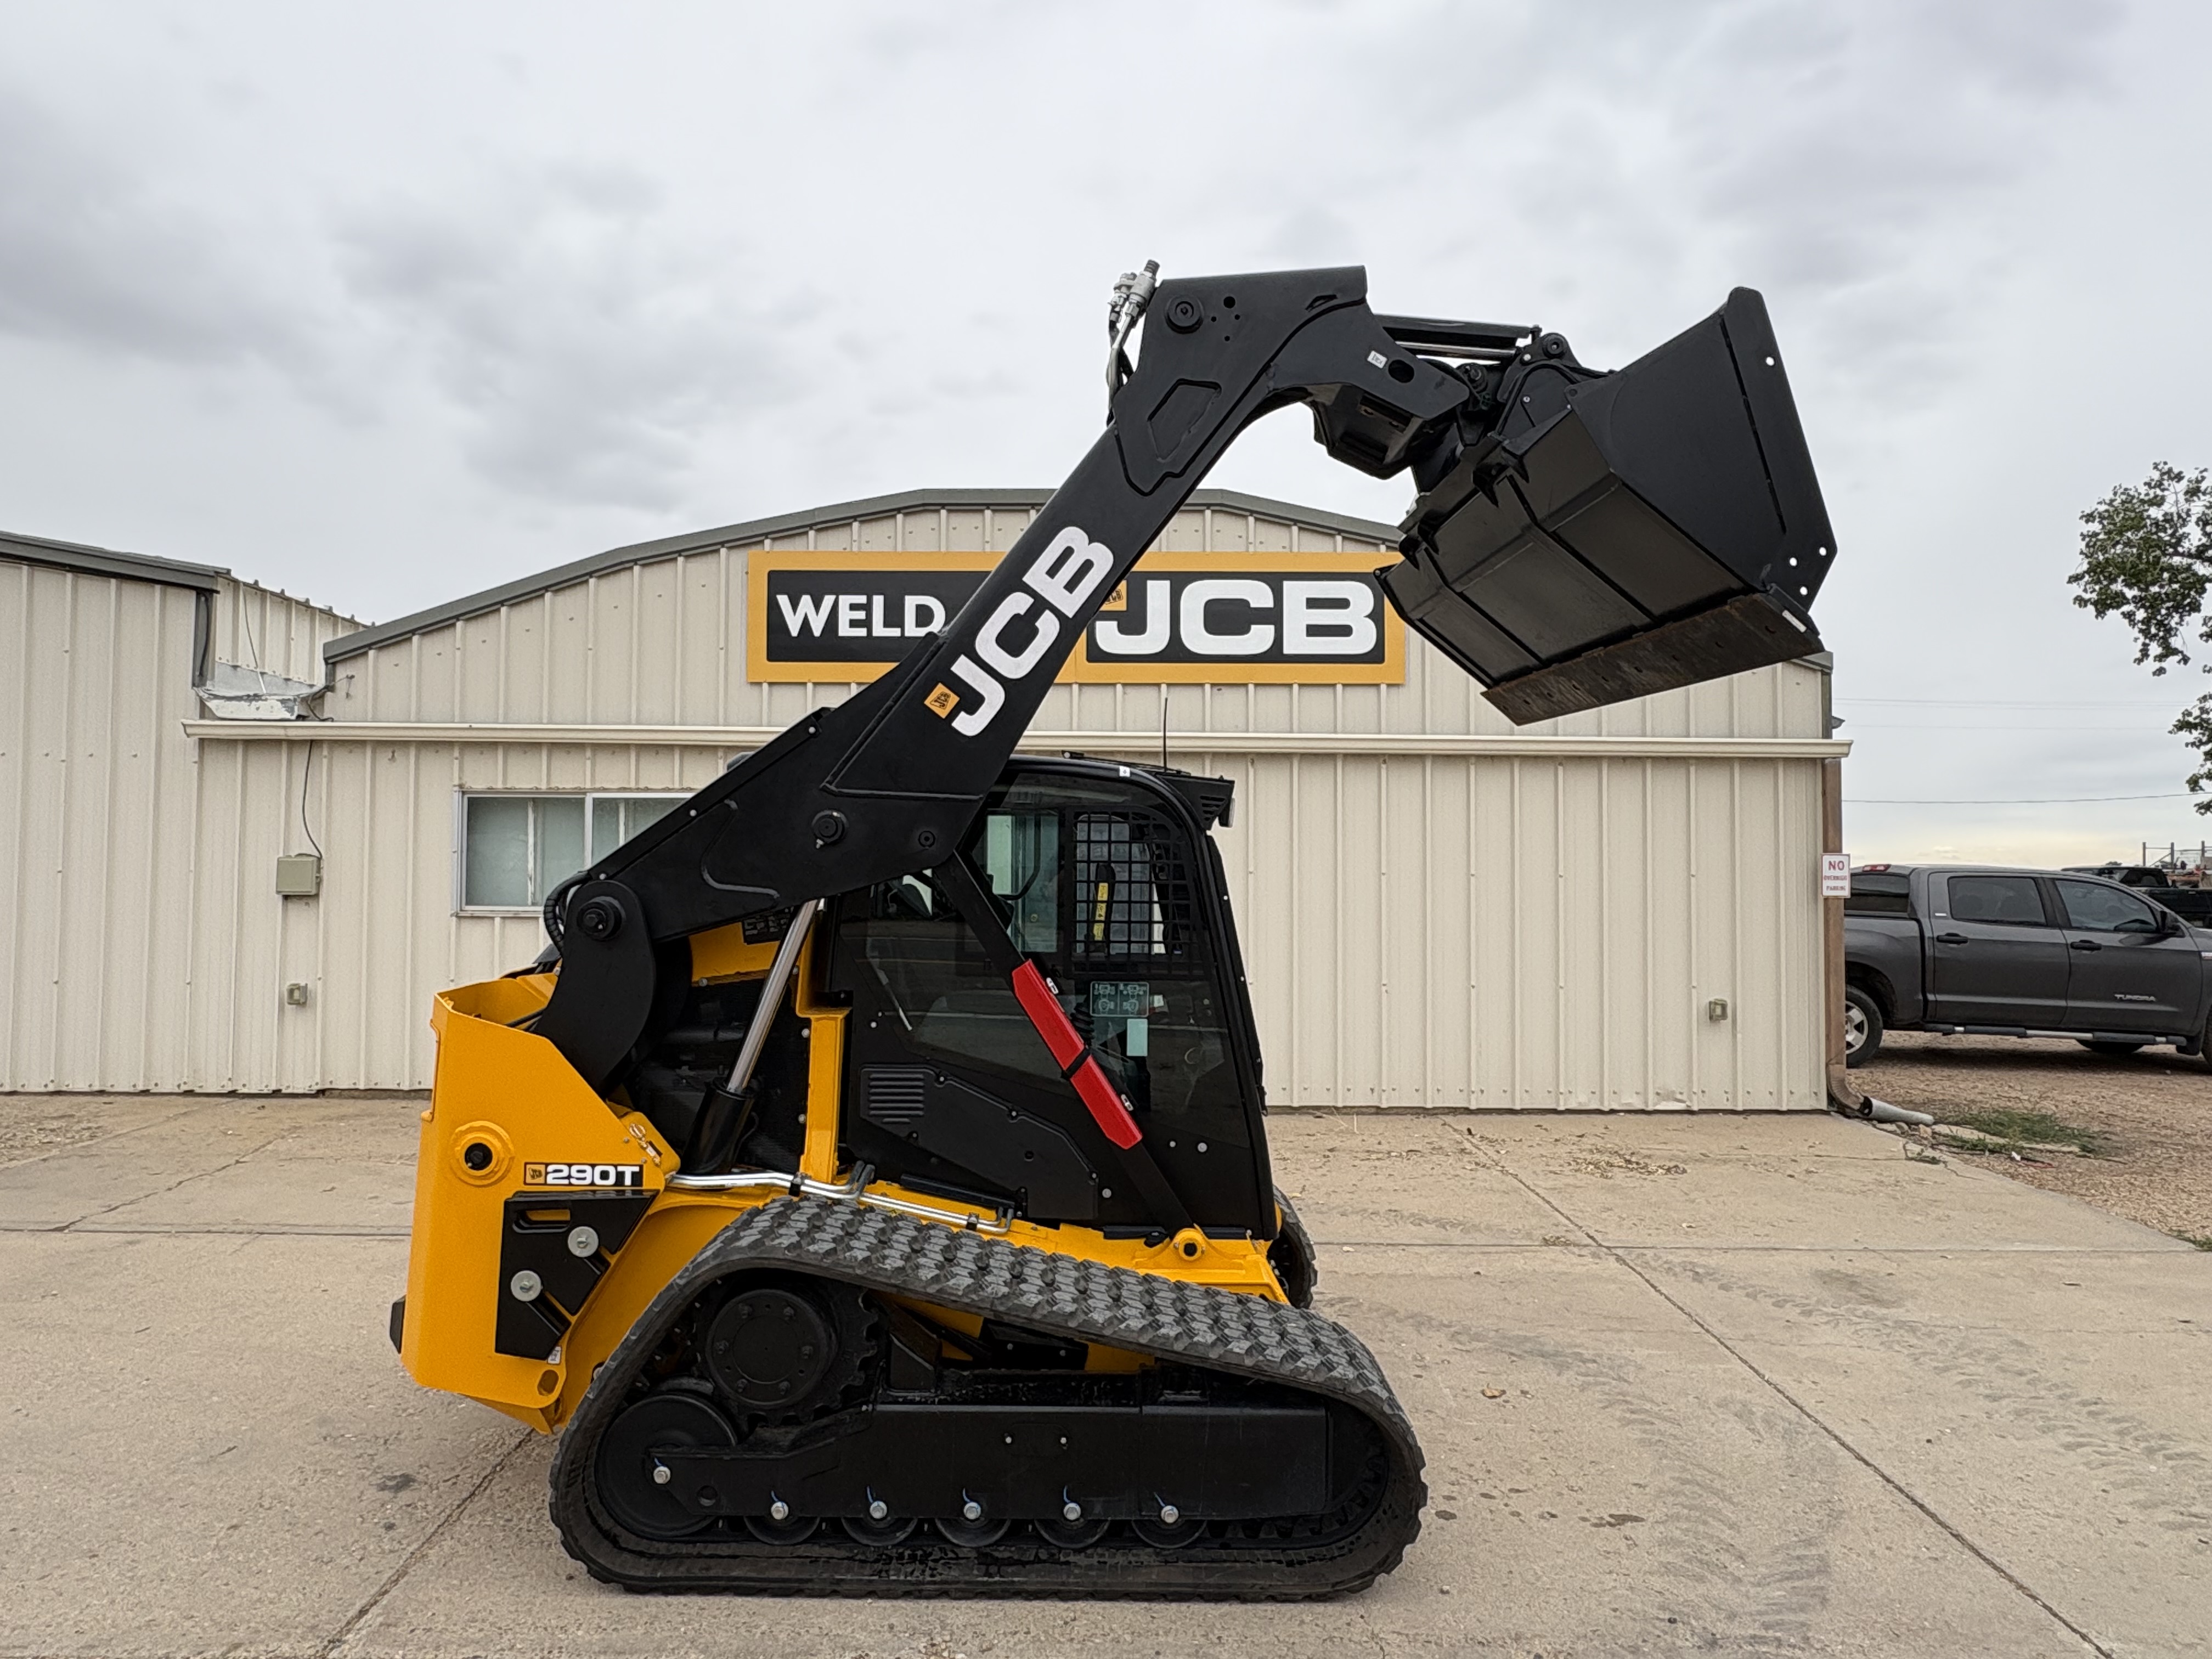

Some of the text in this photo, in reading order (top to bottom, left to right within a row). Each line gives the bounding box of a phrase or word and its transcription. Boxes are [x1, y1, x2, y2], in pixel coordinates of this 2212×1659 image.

[776, 595, 946, 637] WELD
[950, 526, 1114, 736] JCB
[1096, 579, 1376, 655] JCB
[1829, 860, 1844, 871] NO
[546, 1164, 640, 1186] 290T
